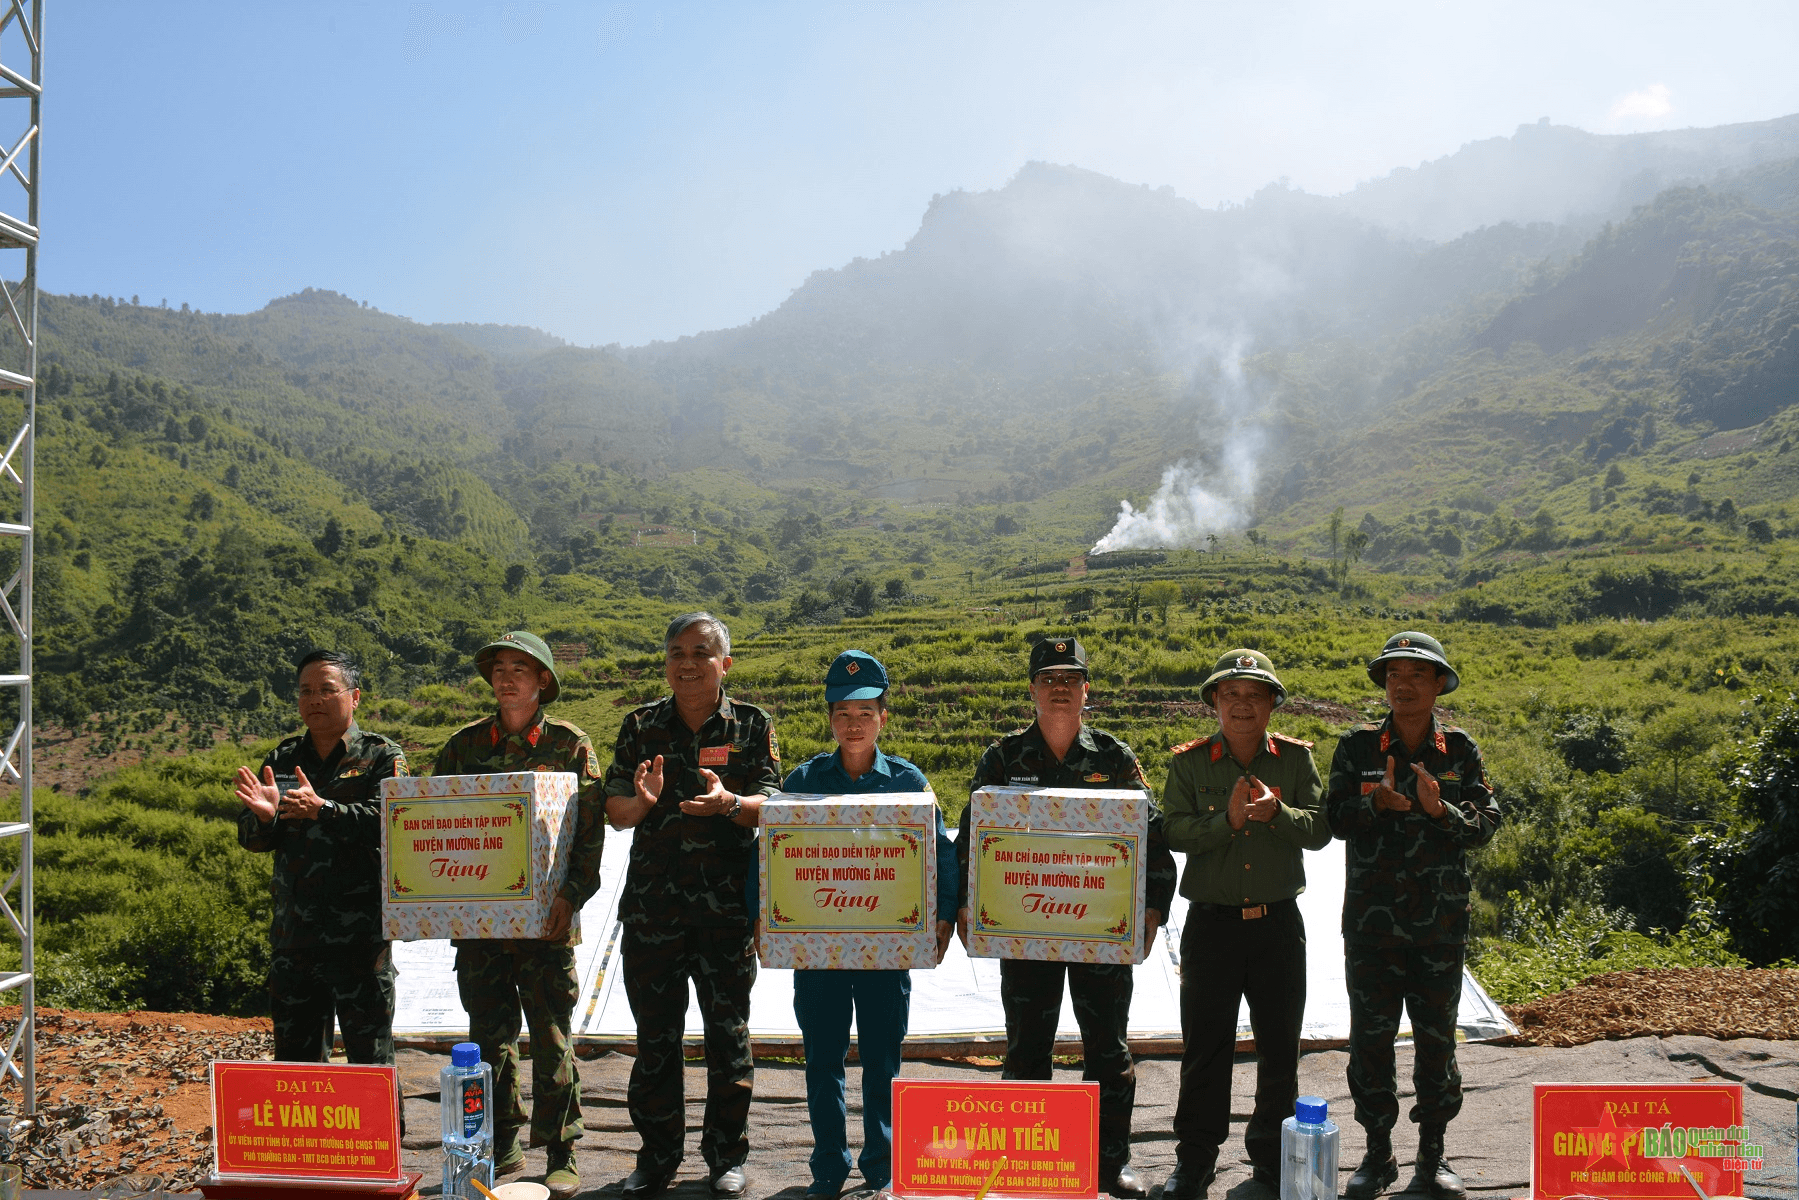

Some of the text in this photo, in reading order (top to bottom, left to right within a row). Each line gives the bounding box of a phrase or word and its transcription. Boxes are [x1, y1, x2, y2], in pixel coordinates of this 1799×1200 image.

[404, 814, 512, 832] BAN CHỈ ĐẠO DIỄN TẬP KVPT
[413, 832, 503, 854] HUYỆN MƯỜNG ẢNG
[785, 843, 906, 861] BAN CHỈ ĐẠO DIỄN TẬP KVPT
[995, 848, 1117, 868] BAN CHỈ ĐẠO DIỄN TẬP KVPT
[429, 858, 491, 882] Tặng
[796, 863, 895, 884] HUYỆN MƯỜNG ẢNG
[1005, 870, 1105, 889] HUYỆN MƯỜNG ẢNG
[814, 888, 881, 913] Tặng
[1022, 893, 1089, 919] Tặng
[276, 1077, 336, 1096] ĐẠI TÁ
[946, 1095, 1046, 1114] ĐỒNG CHÍ
[1645, 1098, 1671, 1115] TÁ
[253, 1099, 360, 1130] LÊ VĂN SƠN
[229, 1132, 236, 1145] ỦY
[238, 1134, 252, 1146] VIÊN
[254, 1137, 264, 1146] BTV
[266, 1134, 280, 1147] TỈNH
[294, 1134, 305, 1148] CHỈ
[306, 1138, 318, 1148] HUY
[345, 1138, 354, 1151] BỘ
[356, 1140, 373, 1150] CHQS
[374, 1138, 389, 1150] TỈNH
[932, 1120, 1060, 1151] LÒ VĂN TIẾN
[244, 1150, 256, 1161] PHÓ
[283, 1153, 297, 1163] BAN
[302, 1154, 315, 1163] TMT
[347, 1154, 359, 1167] TẬP
[361, 1153, 376, 1165] TỈNH
[917, 1155, 935, 1168] TỈNH
[938, 1155, 947, 1169] ỦY
[950, 1157, 972, 1170] VIÊN,
[974, 1158, 990, 1170] PHÓ
[1011, 1160, 1029, 1172] TỊCH
[1032, 1160, 1054, 1171] UBND
[1056, 1158, 1076, 1172] TỈNH
[911, 1172, 928, 1185] PHÓ
[930, 1175, 947, 1185] BAN
[949, 1174, 982, 1186] THƯỜNG
[1007, 1176, 1024, 1187] BAN
[1026, 1174, 1040, 1187] CHỈ
[1042, 1177, 1059, 1190] ĐẠO
[1061, 1175, 1080, 1188] TỈNH
[1591, 1169, 1616, 1183] GIÁM
[1618, 1169, 1637, 1183] ĐỐC
[1639, 1169, 1665, 1183] CÔNG
[1667, 1171, 1680, 1183] AN
